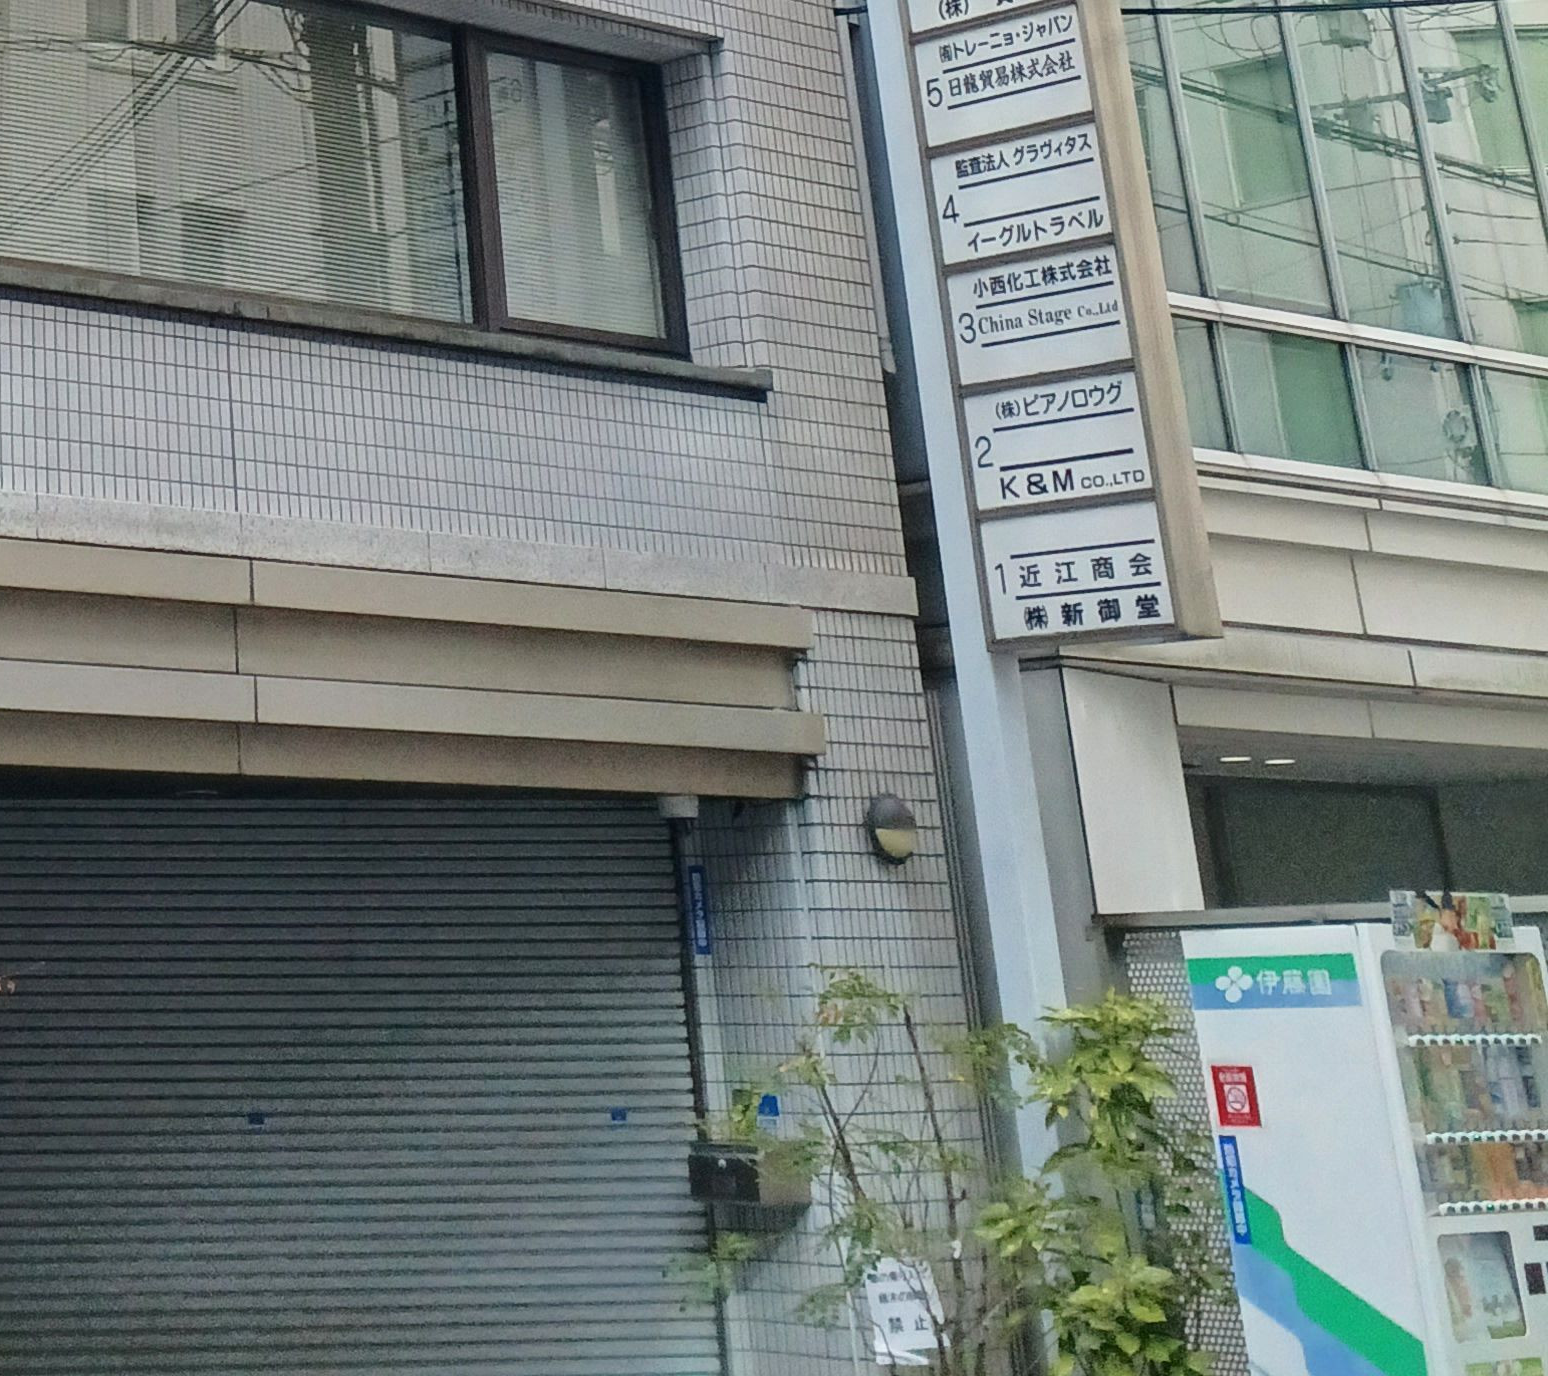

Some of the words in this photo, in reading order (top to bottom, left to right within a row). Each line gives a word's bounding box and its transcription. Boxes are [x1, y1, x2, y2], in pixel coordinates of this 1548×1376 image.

[926, 77, 943, 108] 5
[955, 150, 1010, 179] 監査法人
[942, 194, 960, 224] 4
[973, 255, 1113, 298] 小西化工株式会社
[958, 313, 977, 344] 3
[978, 314, 1023, 335] China
[1028, 305, 1072, 326] Stage
[974, 436, 994, 468] 2
[994, 563, 1007, 594] 1
[1019, 552, 1153, 588] 近江商会
